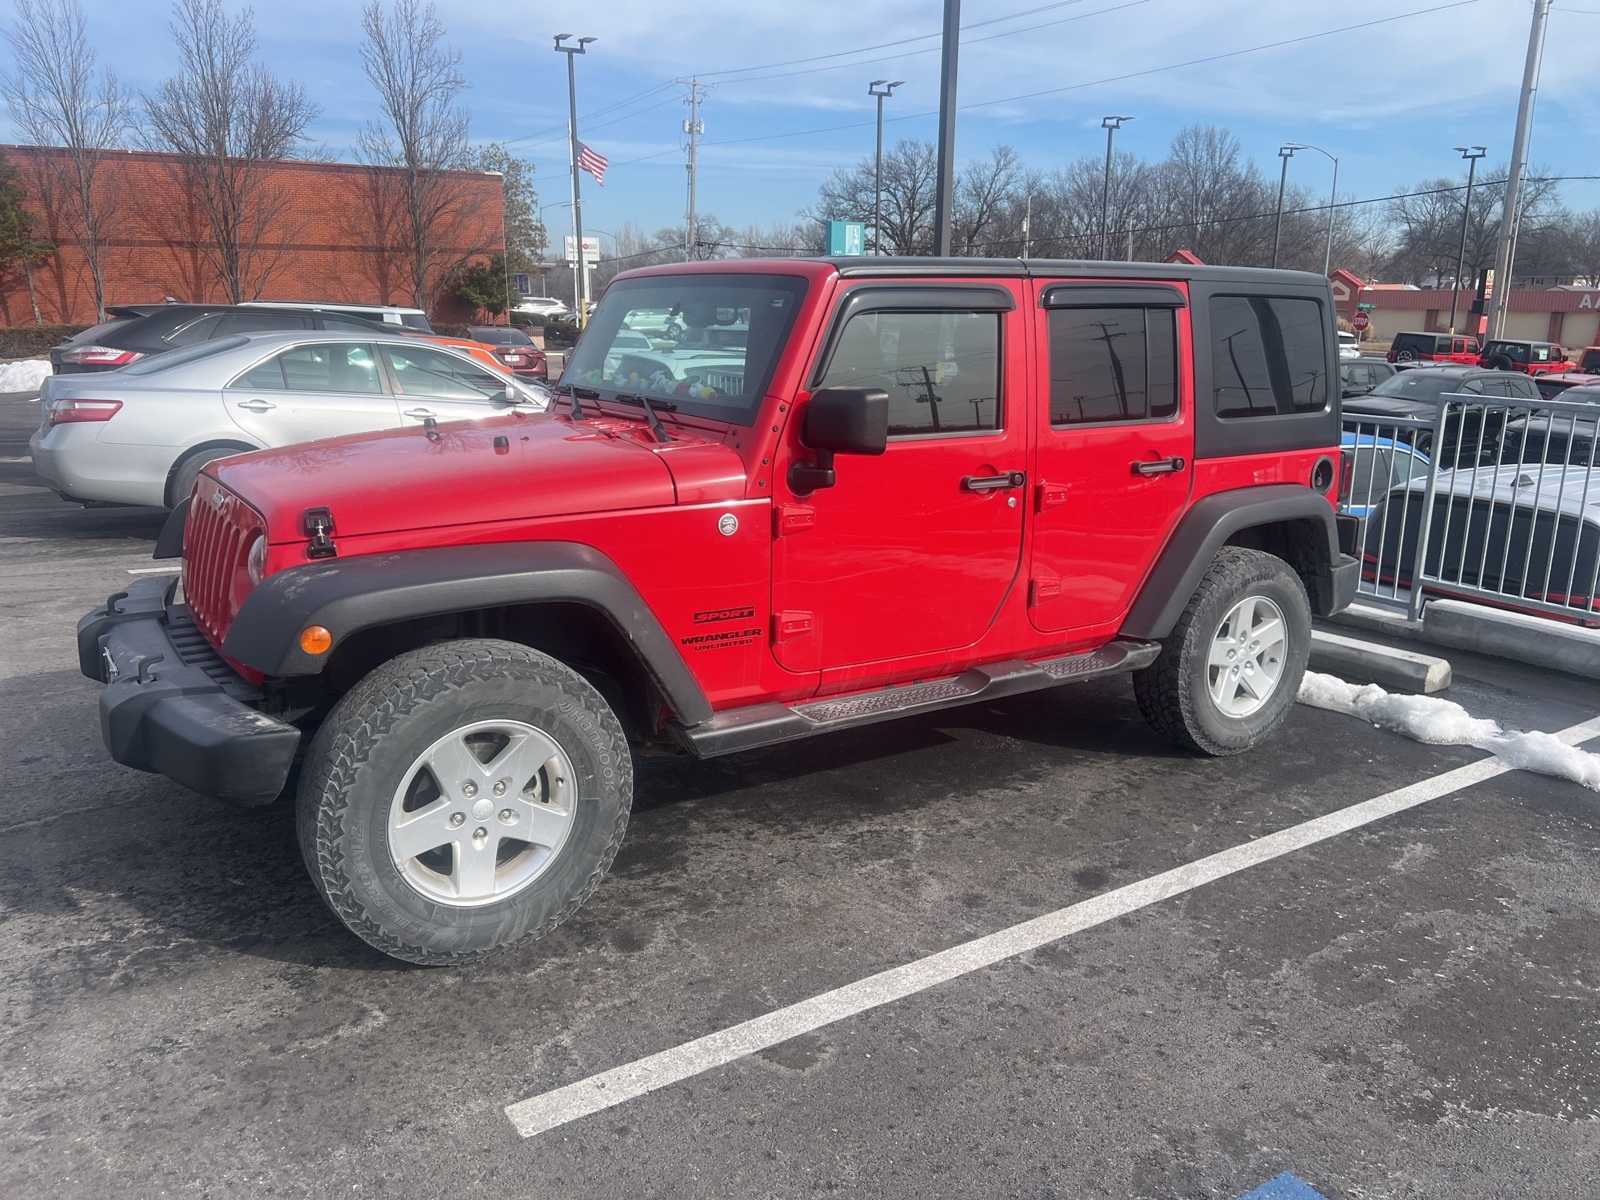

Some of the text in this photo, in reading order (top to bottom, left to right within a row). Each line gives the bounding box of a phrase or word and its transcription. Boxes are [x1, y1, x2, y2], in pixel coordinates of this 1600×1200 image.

[1354, 317, 1369, 326] STOP
[694, 607, 754, 622] SPORT
[681, 628, 762, 645] WRANGLER
[694, 639, 753, 651] UNLIMITED
[568, 708, 614, 792] Hankook
